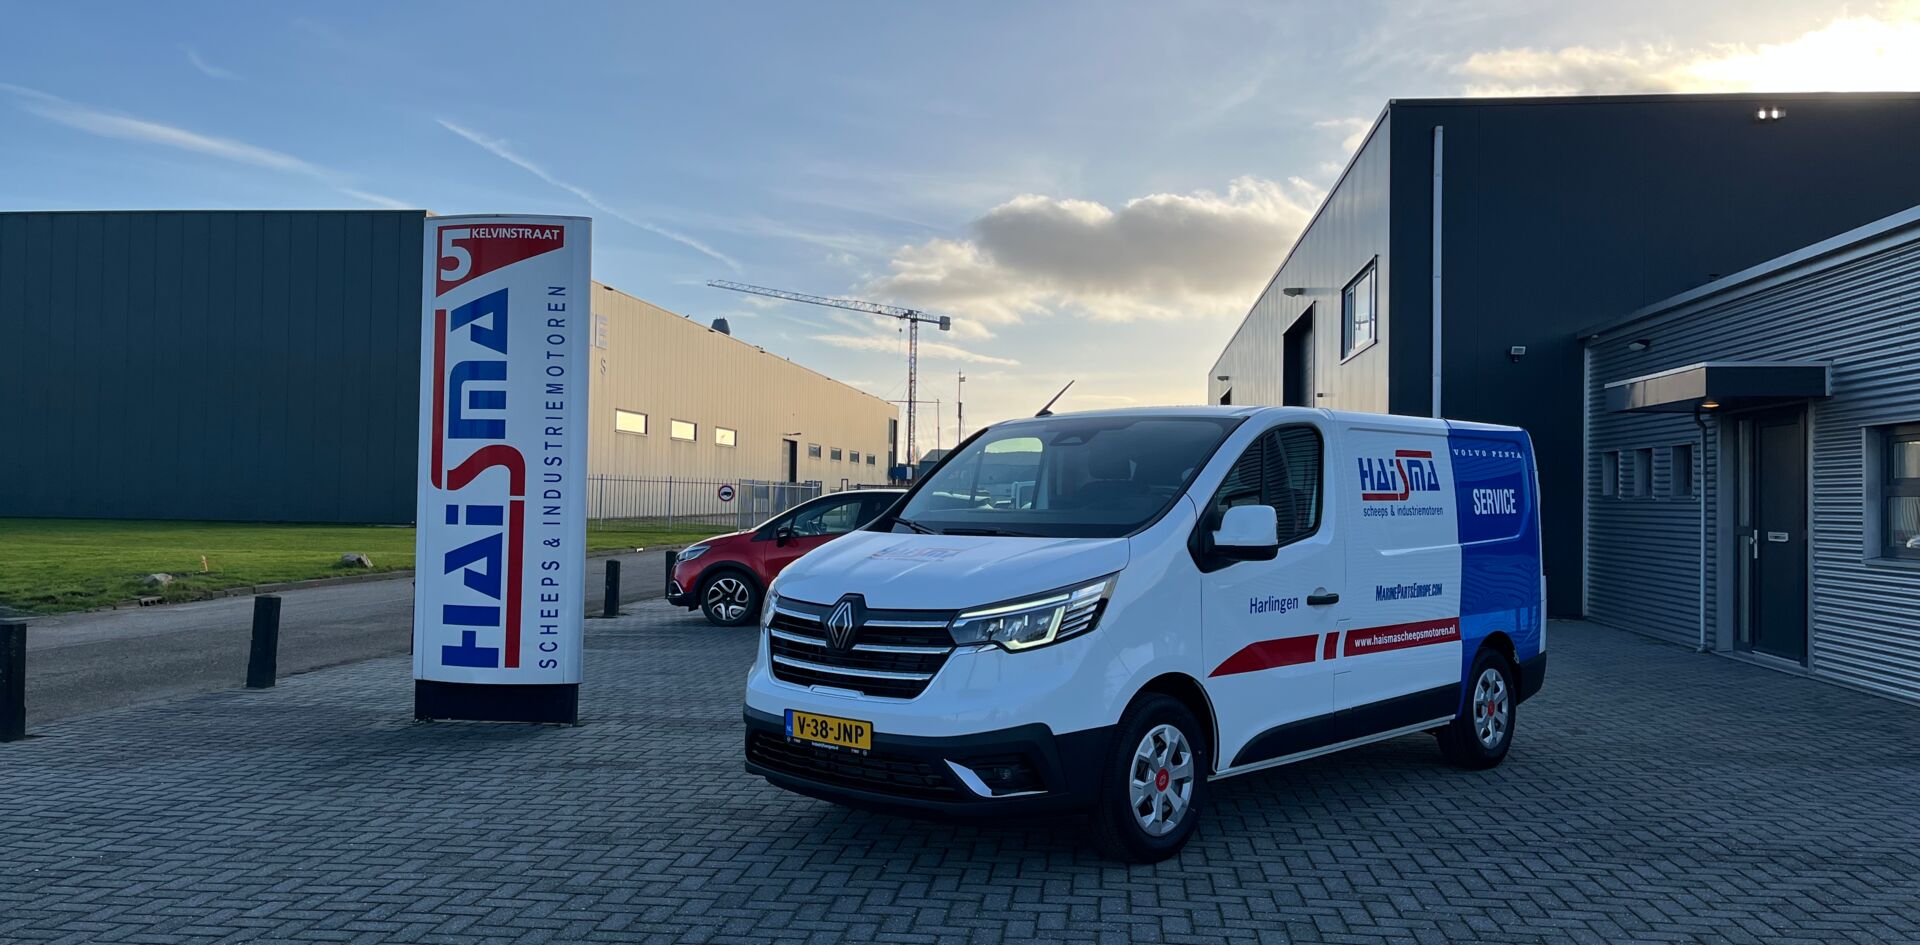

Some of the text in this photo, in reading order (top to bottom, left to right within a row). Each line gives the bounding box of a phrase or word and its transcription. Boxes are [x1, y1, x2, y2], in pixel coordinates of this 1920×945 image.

[472, 228, 560, 240] KELVINSTRAAT
[440, 228, 472, 282] 5
[1453, 449, 1522, 459] VOLVO PENTA
[539, 286, 566, 669] SCHEEPS & INDUSTRIEMOTOREN
[1363, 504, 1444, 518] scheeps & industriemotoren
[1473, 488, 1516, 515] SERVICE
[1250, 596, 1299, 614] Harlingen
[1354, 624, 1456, 648] www.haismascheepsmotoren.nl
[797, 715, 864, 744] V-38-JNP
